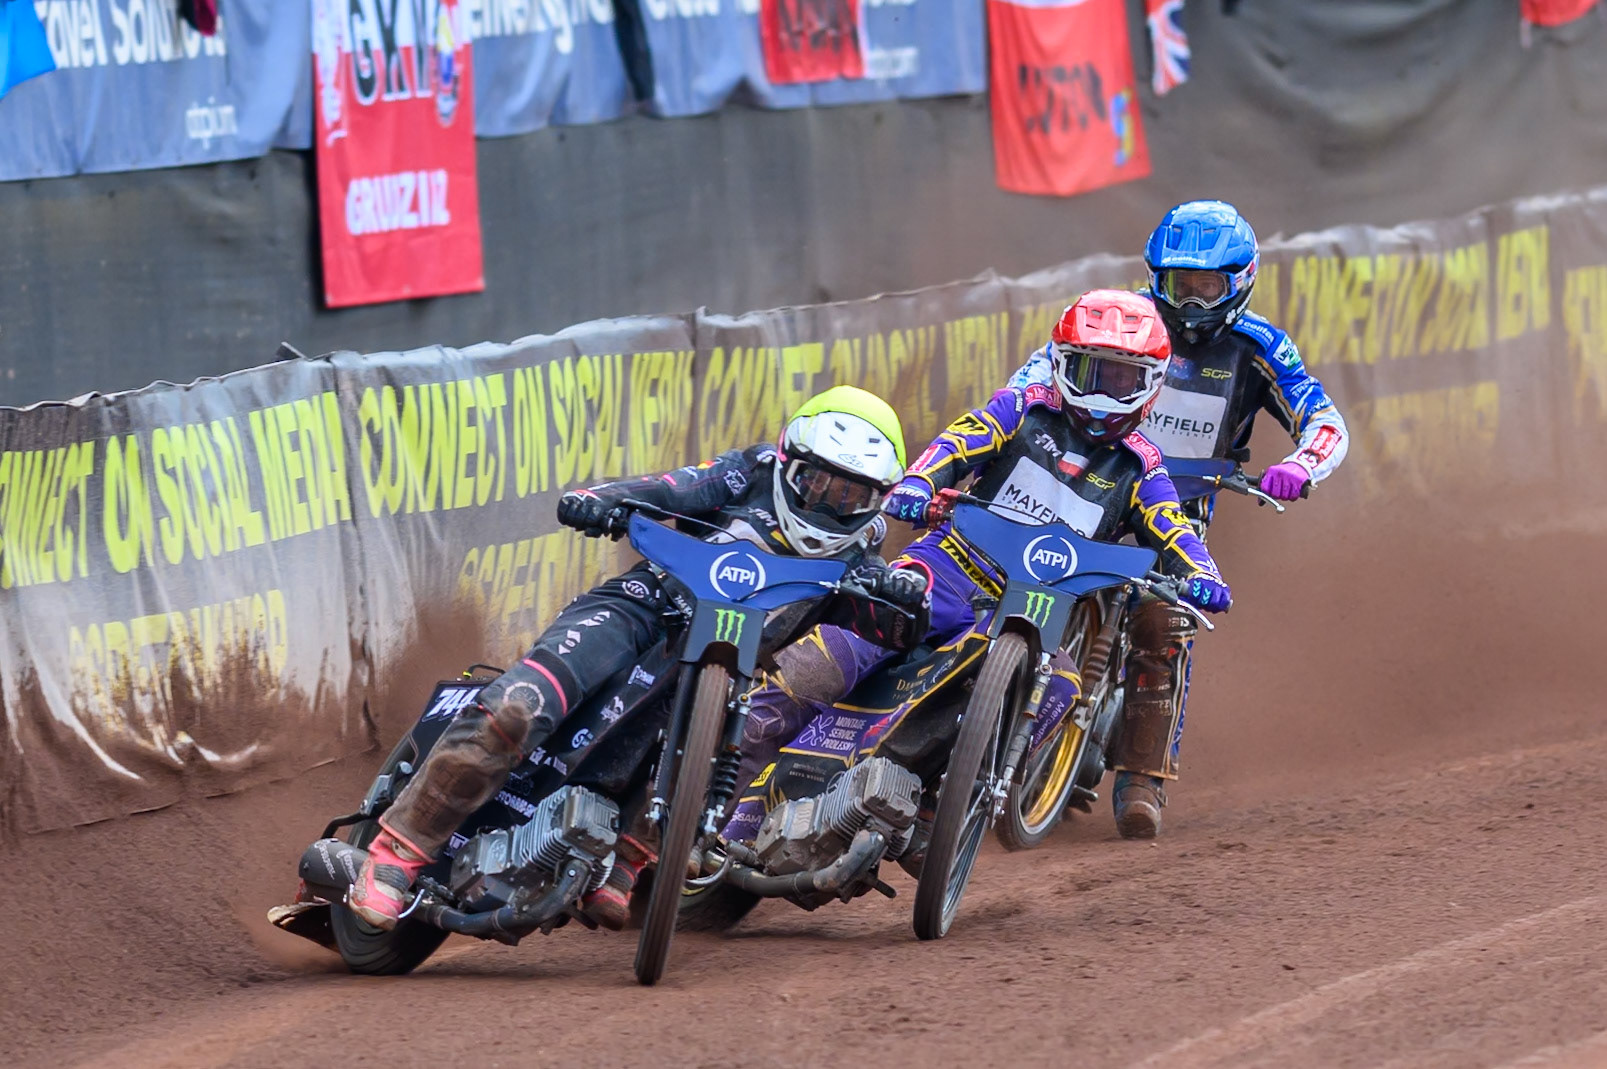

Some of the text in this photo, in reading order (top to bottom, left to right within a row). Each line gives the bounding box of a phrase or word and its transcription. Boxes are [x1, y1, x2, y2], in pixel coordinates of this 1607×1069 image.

[1201, 367, 1232, 380] SGP
[1145, 410, 1215, 434] AYFIELD
[359, 373, 507, 518] CONNECT
[512, 365, 549, 498] ON
[1039, 433, 1063, 457] FIM
[1085, 472, 1116, 490] SGP
[104, 434, 154, 573] ON
[153, 416, 265, 565] SOCIAL
[1031, 548, 1068, 570] ATPI
[717, 565, 756, 586] ATPI
[426, 687, 482, 718] 744
[829, 727, 857, 741] SERVICE
[835, 716, 867, 730] MONTAGE
